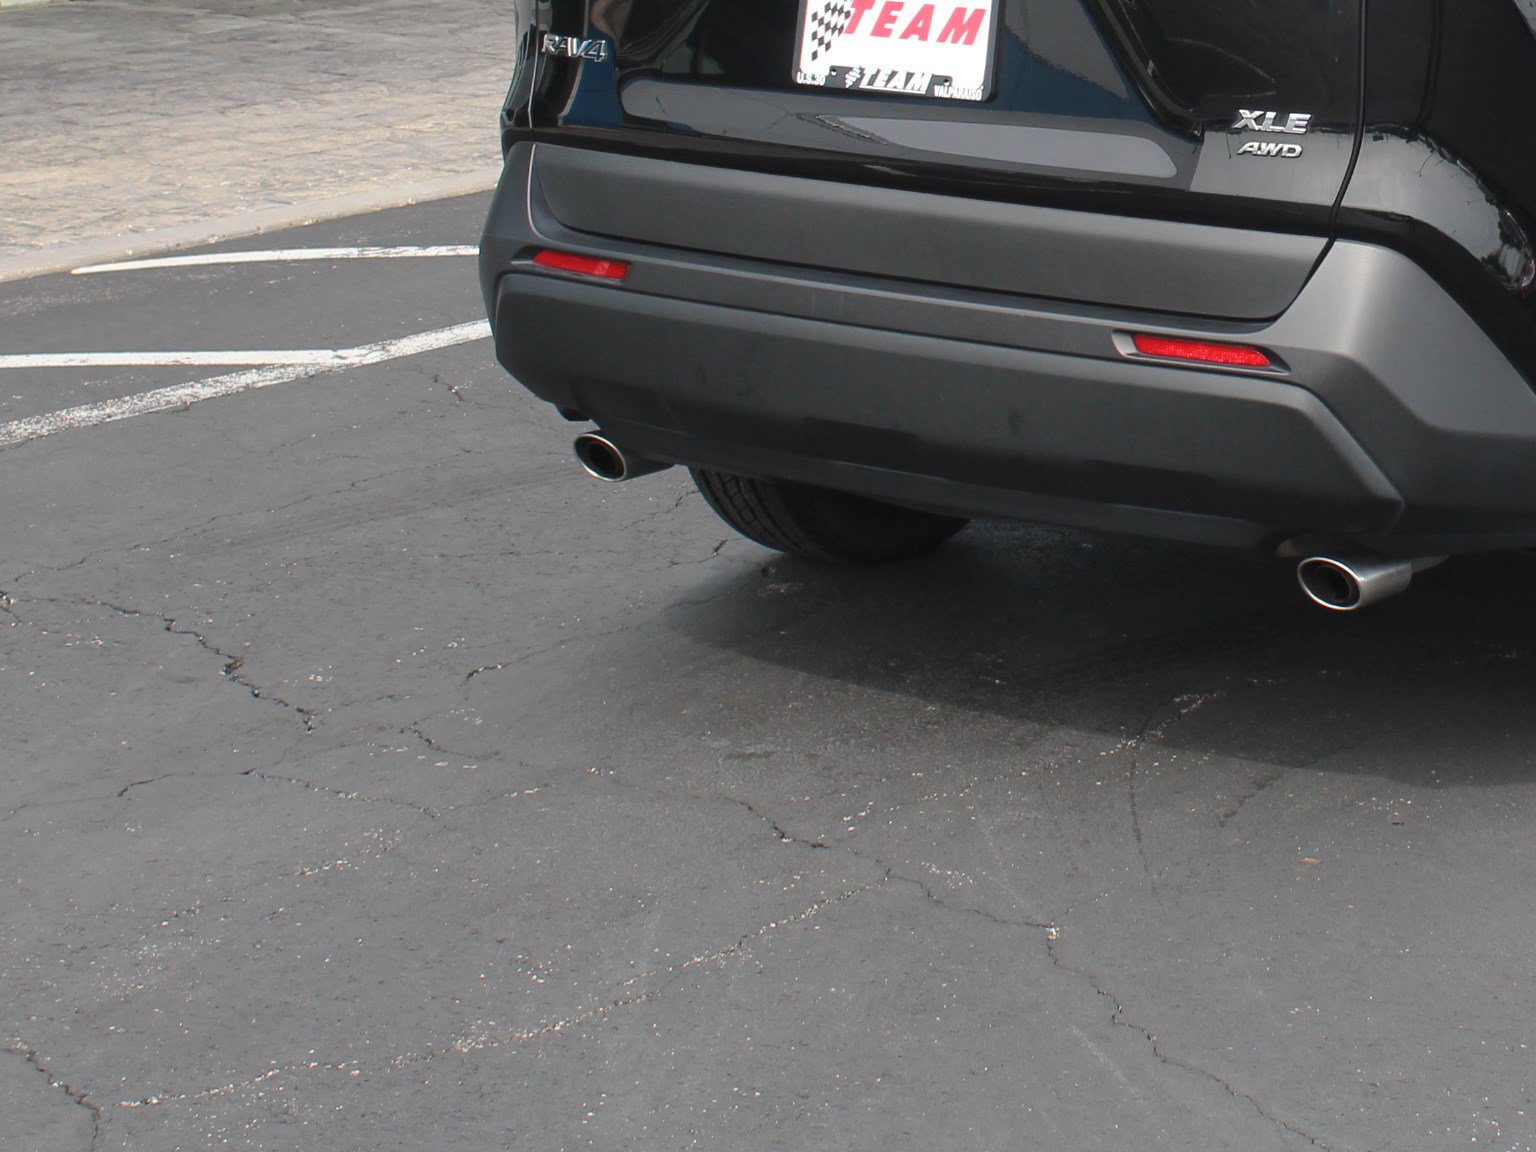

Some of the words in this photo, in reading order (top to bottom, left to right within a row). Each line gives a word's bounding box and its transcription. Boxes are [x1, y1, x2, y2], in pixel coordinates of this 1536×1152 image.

[541, 33, 607, 63] RAV4
[860, 67, 933, 93] TEAM
[933, 84, 983, 101] VALPARAISO
[1232, 109, 1312, 134] XLE
[1236, 140, 1303, 158] AWD
